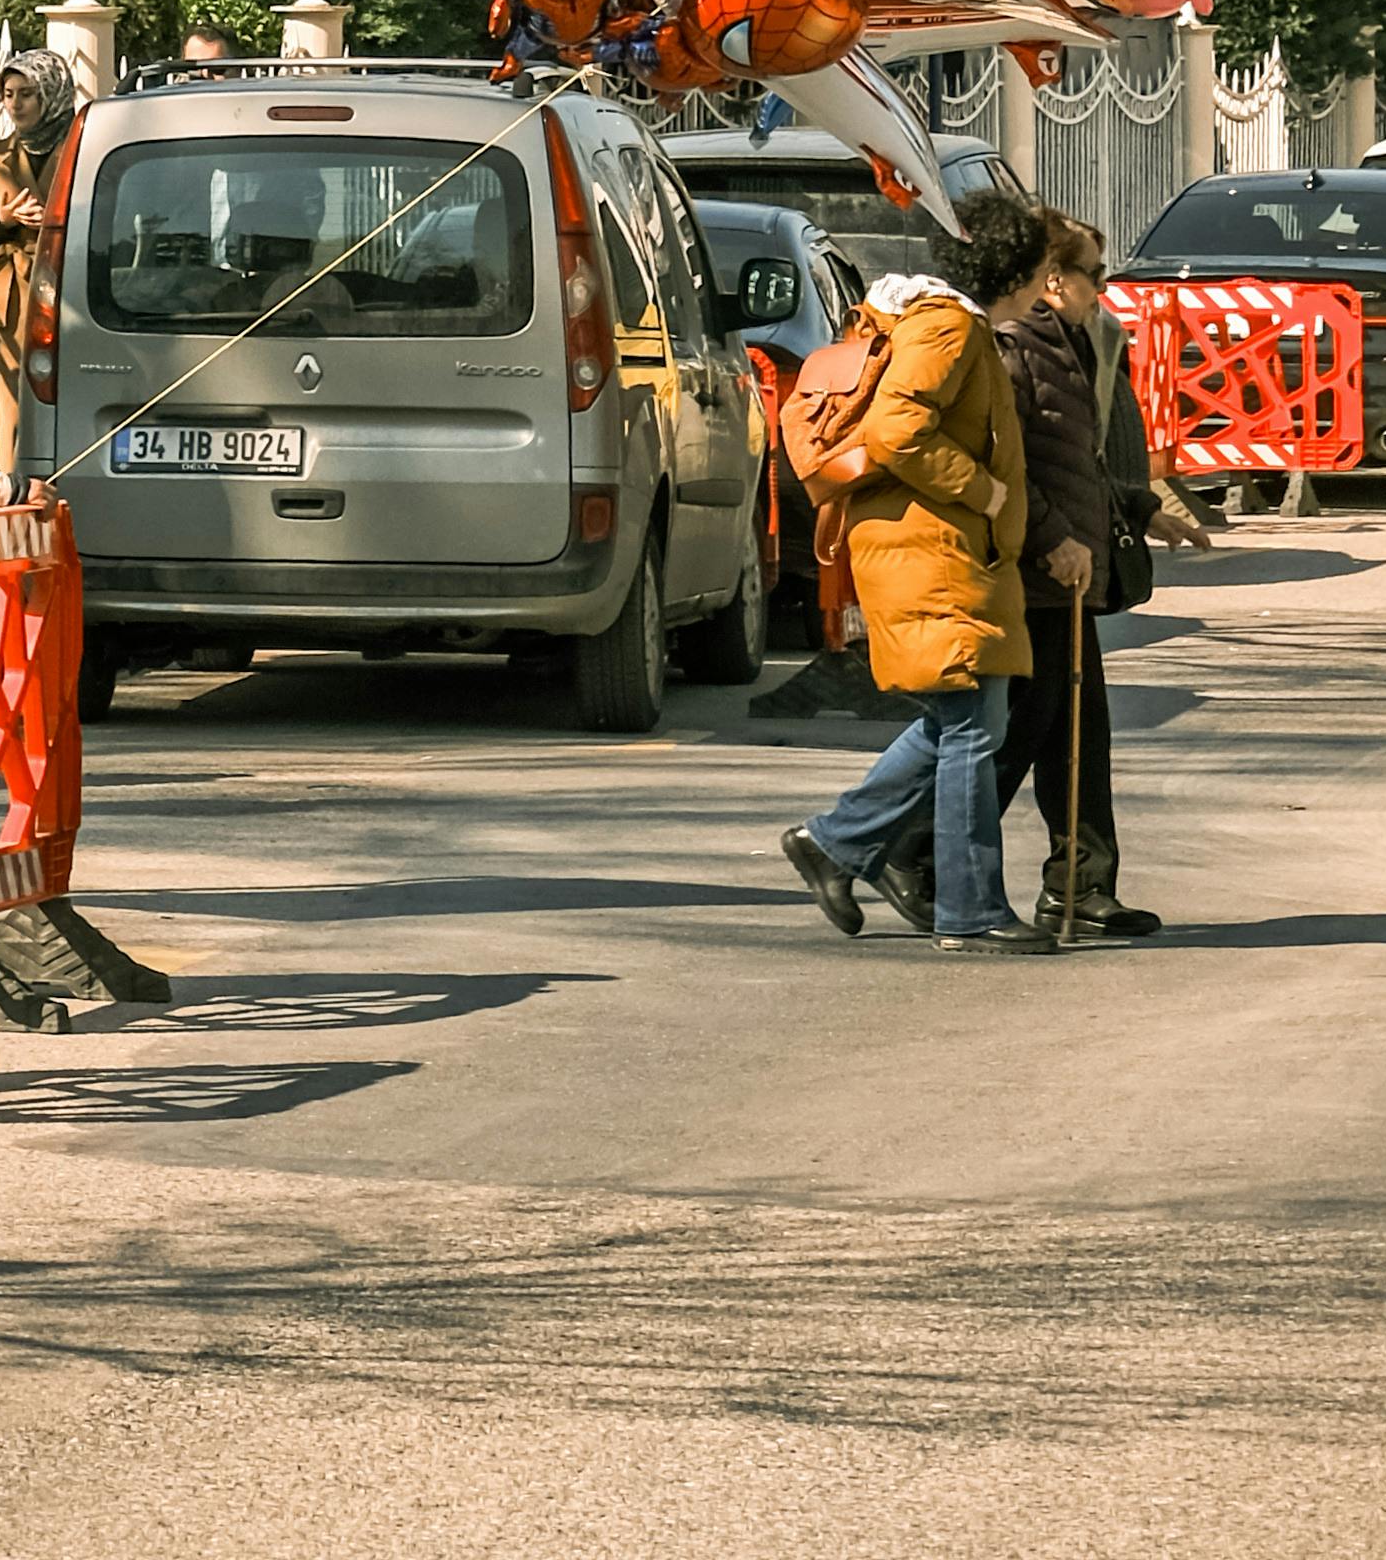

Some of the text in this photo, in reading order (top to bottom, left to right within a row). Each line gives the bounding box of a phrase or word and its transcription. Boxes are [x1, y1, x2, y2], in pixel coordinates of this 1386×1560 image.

[133, 430, 166, 460] 34
[178, 430, 213, 461] HB
[222, 431, 291, 463] 9024
[181, 463, 219, 472] DELTA
